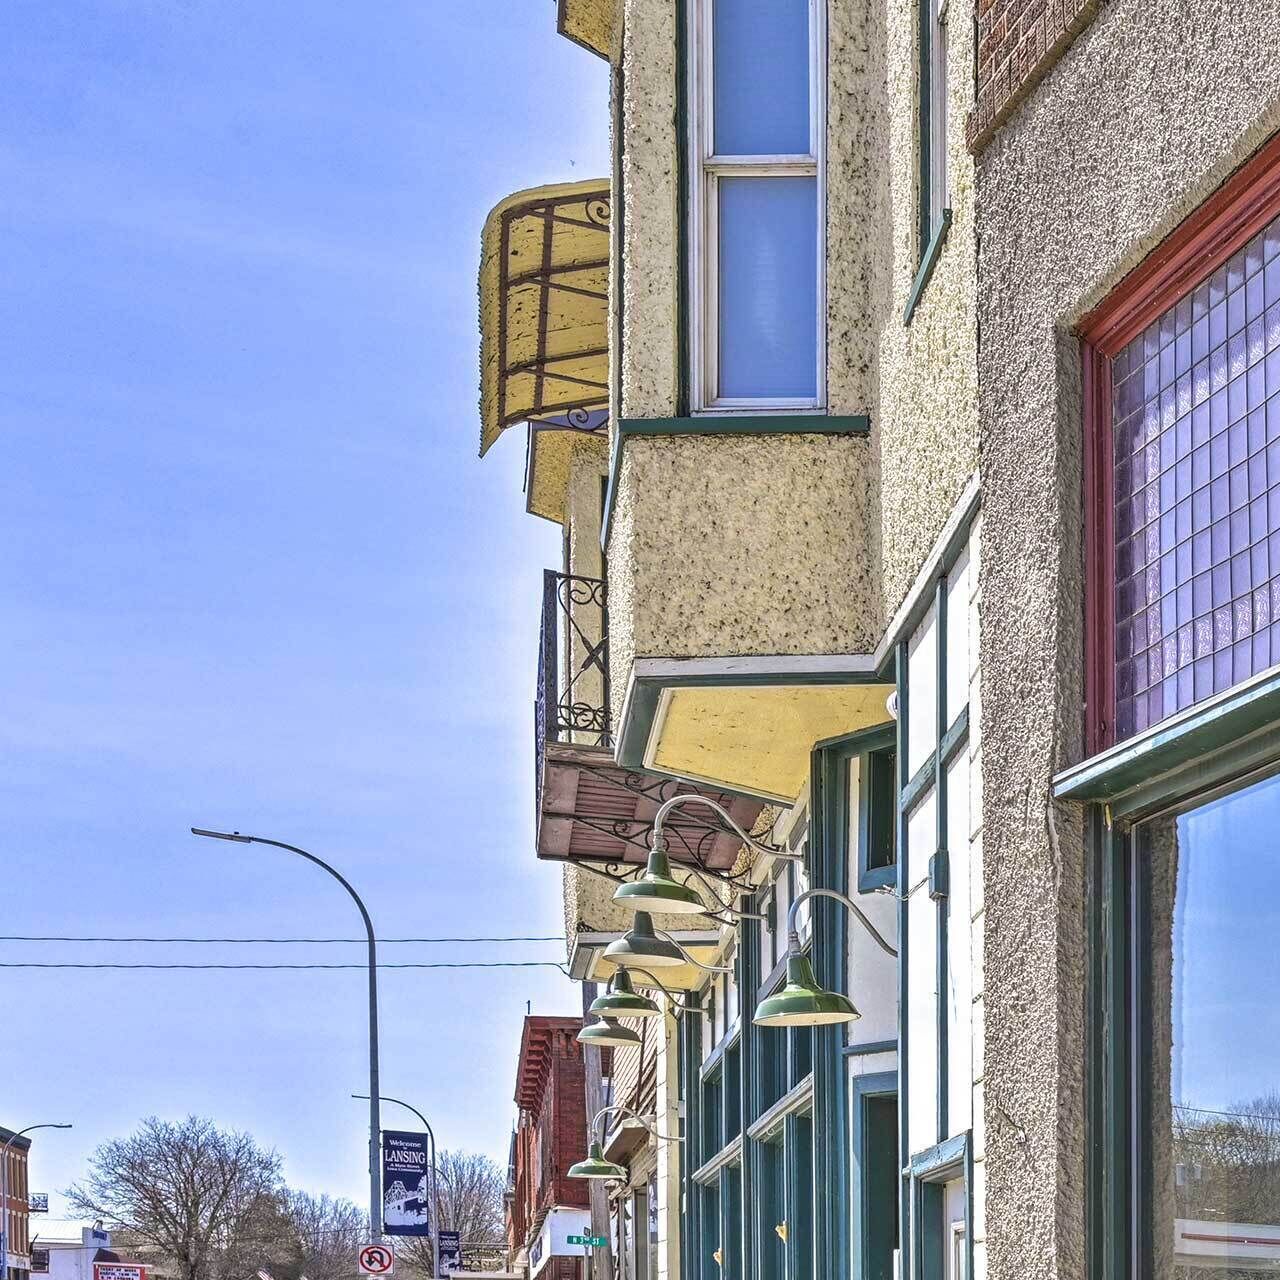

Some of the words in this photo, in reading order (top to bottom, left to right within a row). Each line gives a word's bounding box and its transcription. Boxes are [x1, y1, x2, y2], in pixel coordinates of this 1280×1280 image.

[389, 1140, 421, 1148] Welcome
[385, 1150, 426, 1163] LANSING
[592, 1238, 600, 1246] ST
